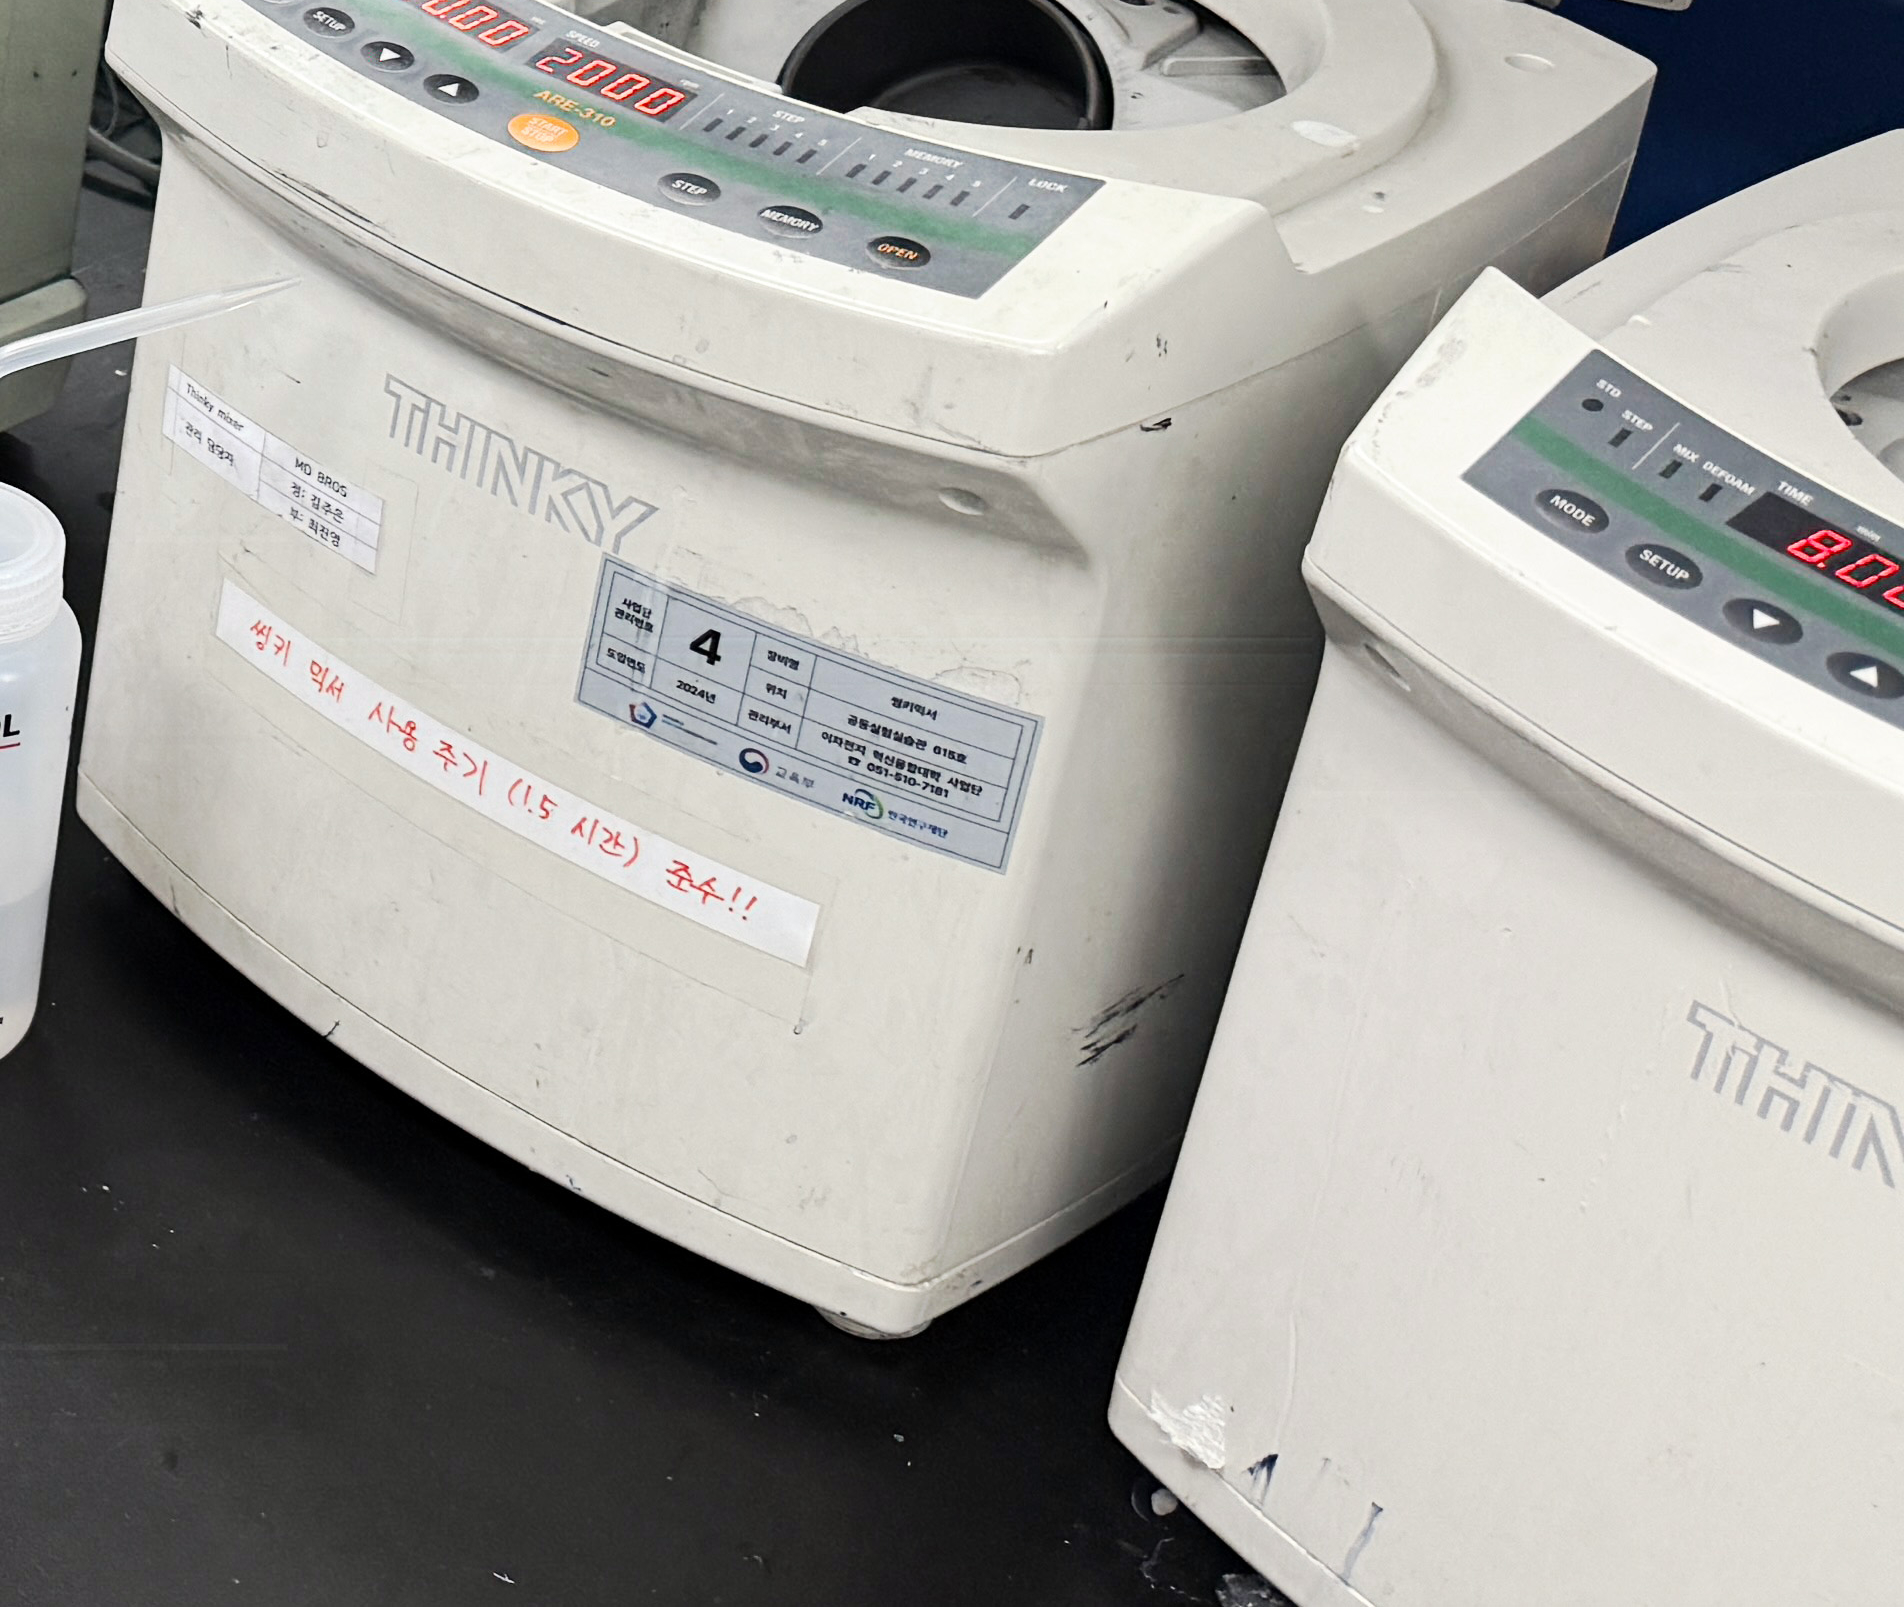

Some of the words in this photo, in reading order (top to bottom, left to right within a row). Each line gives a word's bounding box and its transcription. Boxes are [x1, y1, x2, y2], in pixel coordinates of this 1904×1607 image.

[312, 10, 346, 32] SETUP
[536, 47, 687, 117] 2000
[534, 89, 617, 128] ARE-310
[772, 110, 806, 124] STEP
[904, 148, 963, 169] MEMORY
[671, 178, 708, 196] STEP
[1028, 177, 1068, 194] LOCK
[760, 207, 820, 233] MEMORY
[876, 242, 919, 261] OPEN
[1595, 378, 1622, 398] STD
[1621, 409, 1654, 433] STEP
[383, 372, 660, 556] THINKY
[1672, 443, 1701, 464] MIX
[1702, 461, 1755, 497] DEFOAM
[294, 457, 312, 476] MD
[317, 471, 348, 498] BROS
[1777, 480, 1814, 507] TIME
[1549, 494, 1596, 528] MODE
[1639, 549, 1690, 582] SETUP
[689, 628, 722, 666] 4
[675, 679, 717, 704] 2024년
[249, 619, 292, 667] 씽키
[367, 701, 419, 752] 사용
[432, 739, 488, 796] 주기
[570, 816, 641, 869] 시간)
[665, 859, 758, 921] 준수!!
[775, 765, 815, 790] 교육부
[947, 776, 983, 797] 사업단
[842, 792, 877, 813] NRF
